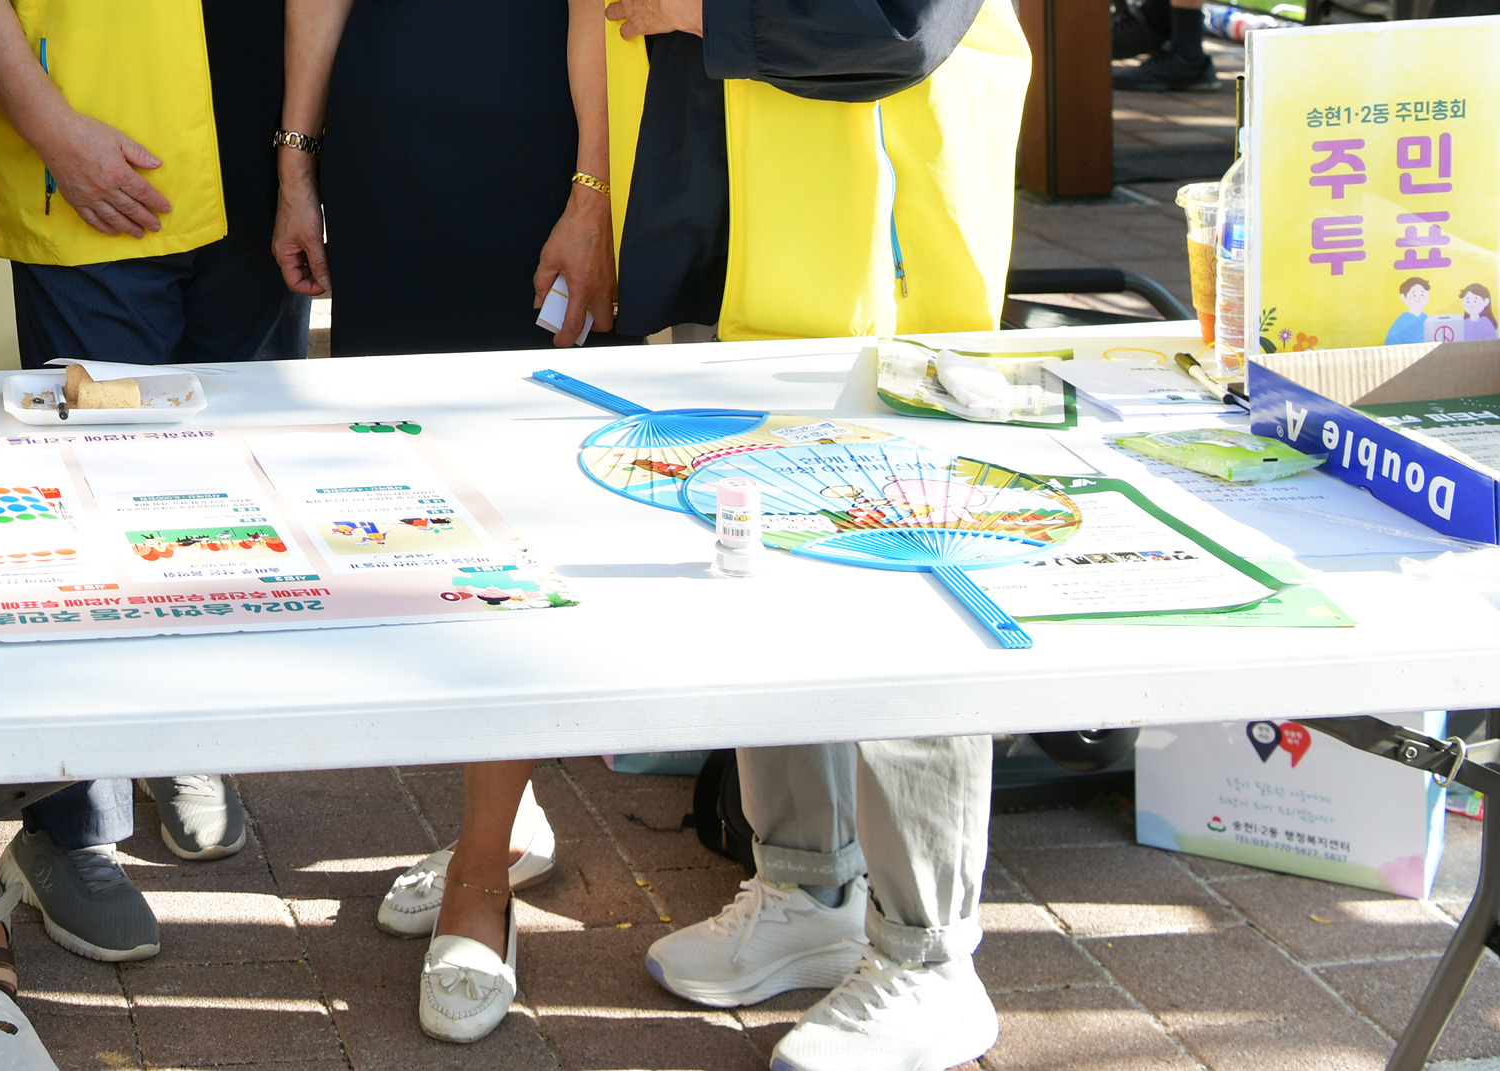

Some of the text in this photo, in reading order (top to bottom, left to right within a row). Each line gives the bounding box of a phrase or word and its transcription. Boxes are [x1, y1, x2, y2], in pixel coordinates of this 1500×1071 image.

[1307, 99, 1466, 127] 송현1·2동 주민총회
[1322, 420, 1455, 521] Double
[127, 591, 204, 605] 우리마을
[209, 589, 267, 601] 추진할
[272, 586, 331, 599] 내년에
[64, 595, 121, 608] 사업에
[242, 599, 324, 613] 2024
[89, 603, 234, 622] 송현1·2동
[1284, 830, 1350, 852] 행정복지센터
